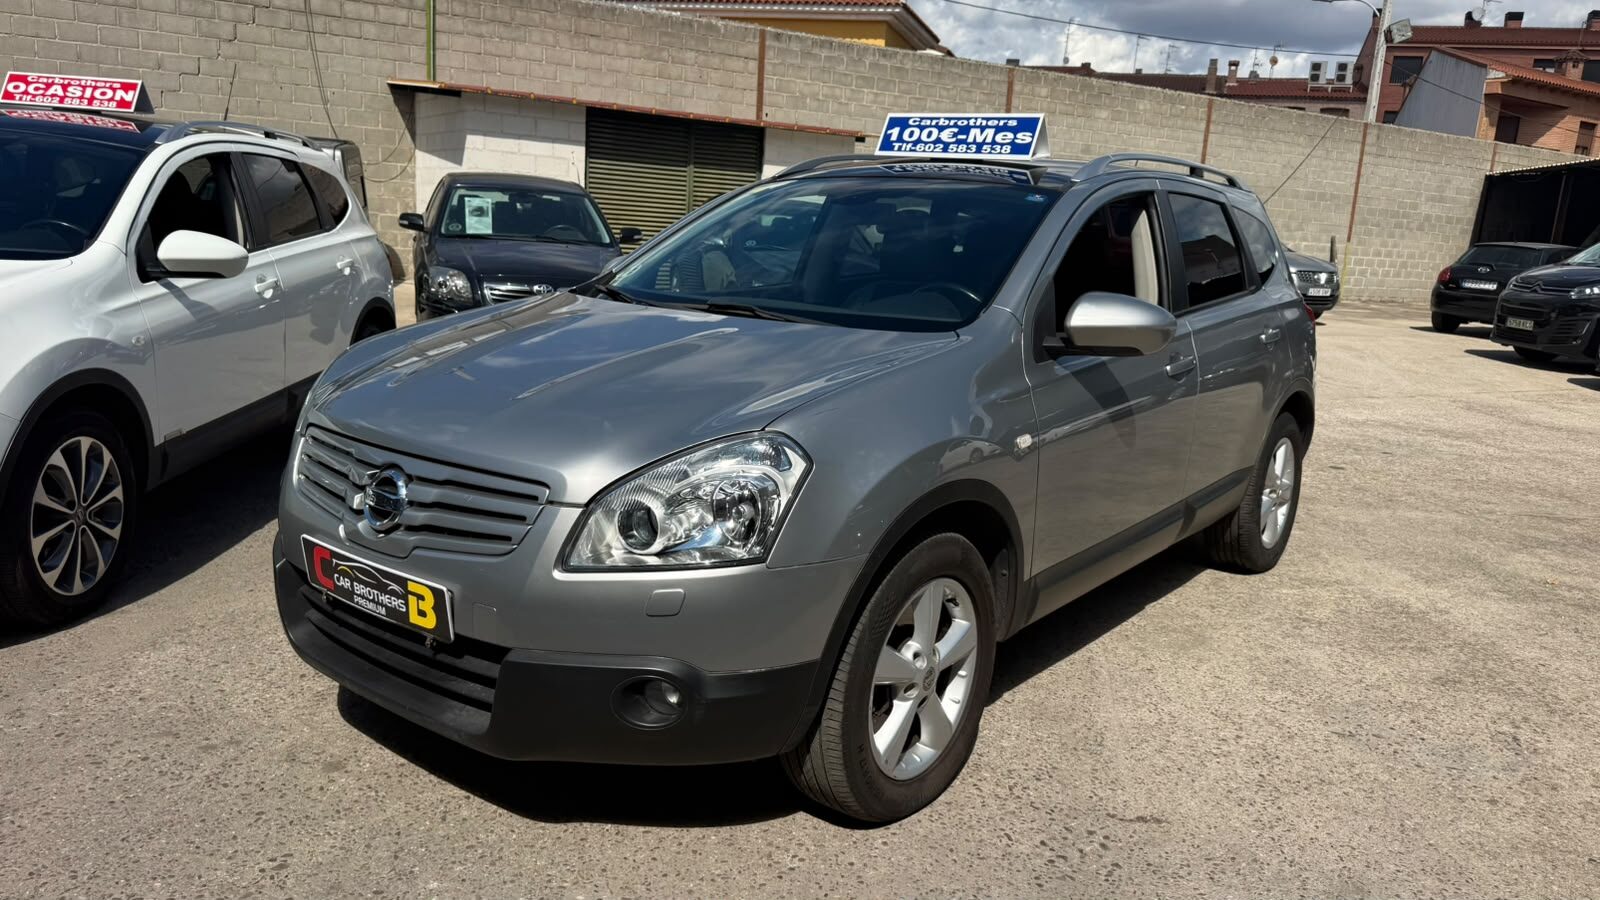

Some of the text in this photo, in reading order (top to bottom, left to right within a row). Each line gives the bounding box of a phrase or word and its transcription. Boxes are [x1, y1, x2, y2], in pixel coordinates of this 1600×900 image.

[27, 76, 121, 88] Carbrothers
[7, 82, 135, 101] OCASION
[13, 93, 117, 108] Tlf-602 583 538
[908, 117, 1018, 127] Carbrothers
[886, 127, 1033, 144] 100€-Mes
[892, 143, 1012, 154] Tlf-602 583 538
[314, 546, 334, 591] C
[334, 573, 407, 612] CAR BROTHERS
[353, 595, 387, 616] PREMIUM
[407, 580, 437, 630] B
